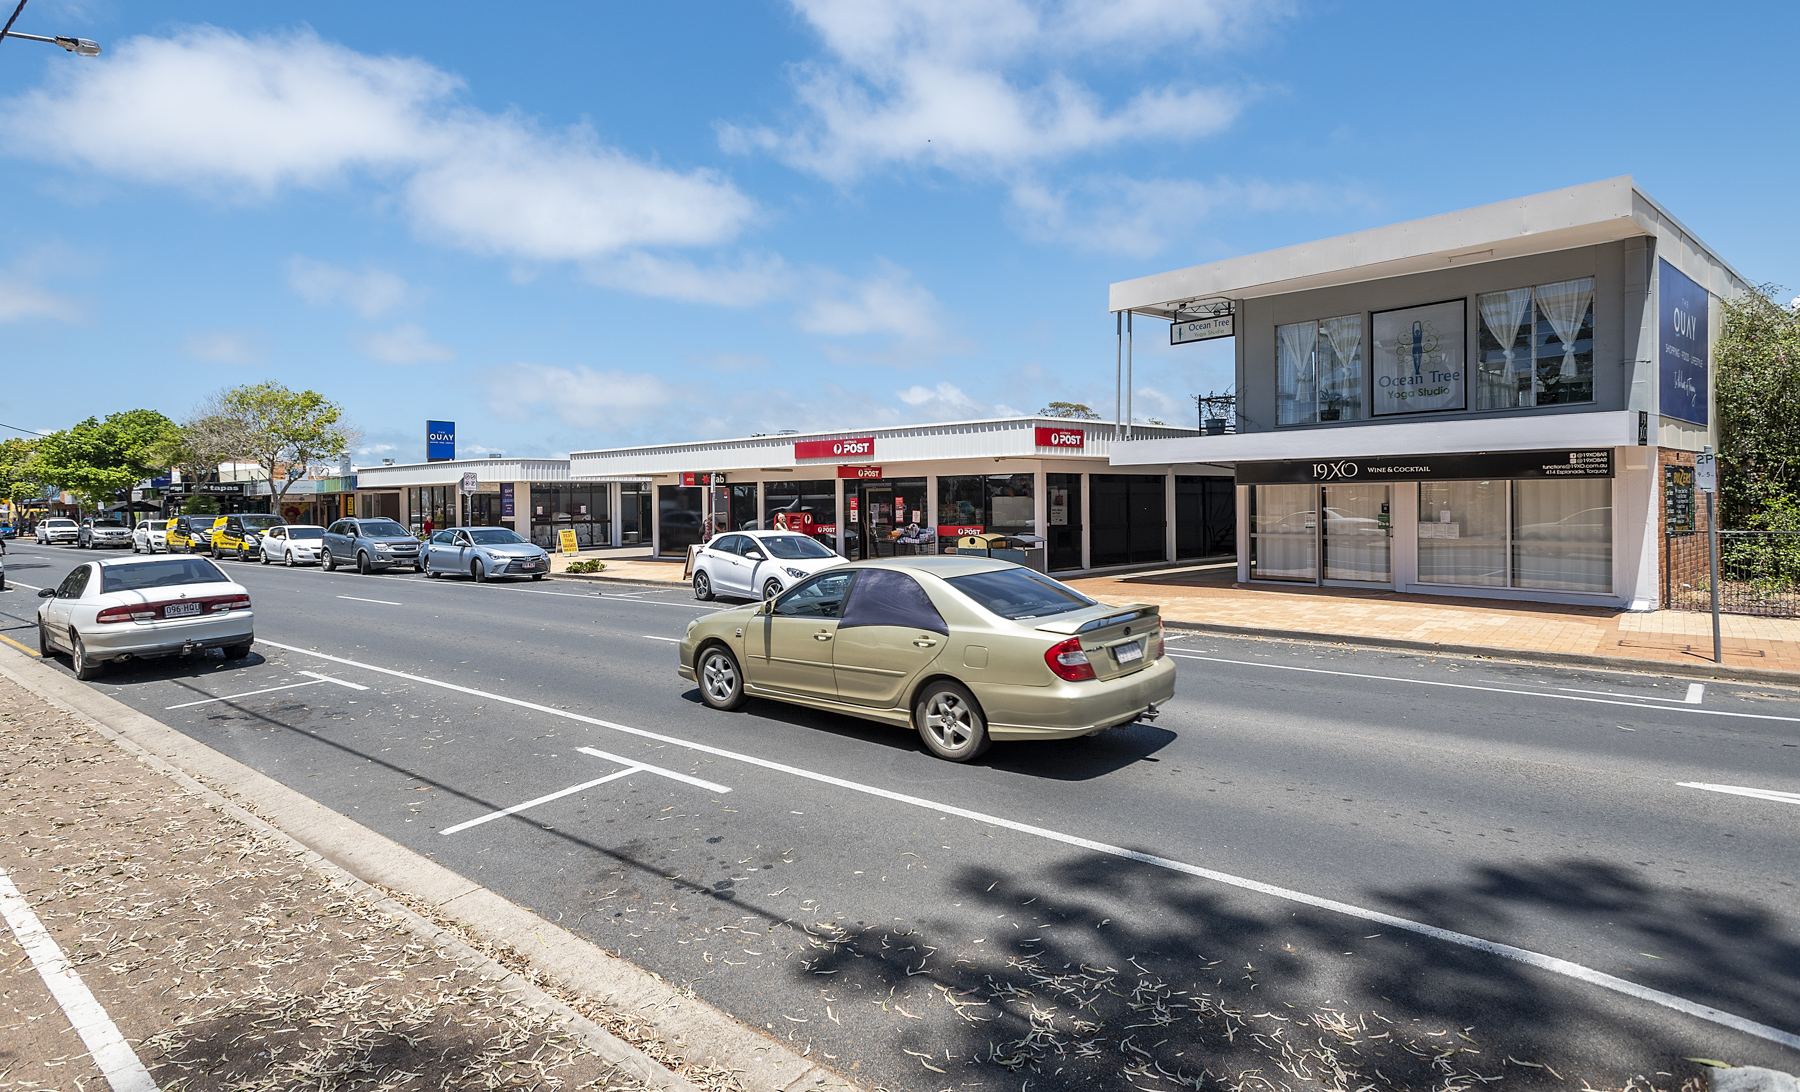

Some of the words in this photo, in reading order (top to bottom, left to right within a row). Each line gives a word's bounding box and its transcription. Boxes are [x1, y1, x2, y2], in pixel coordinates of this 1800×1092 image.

[1188, 322, 1211, 332] Ocean
[1214, 319, 1230, 328] Tree
[1673, 307, 1697, 341] QUAY
[1208, 328, 1225, 336] Studio
[1378, 374, 1424, 388] Ocean
[1429, 370, 1460, 383] Tree
[1387, 390, 1415, 400] Yoga
[1418, 386, 1451, 397] Studio
[429, 433, 454, 441] QUAY
[1060, 434, 1081, 445] POST
[843, 443, 870, 454] POST
[1696, 454, 1714, 465] 2P
[1312, 460, 1359, 480] 19XO
